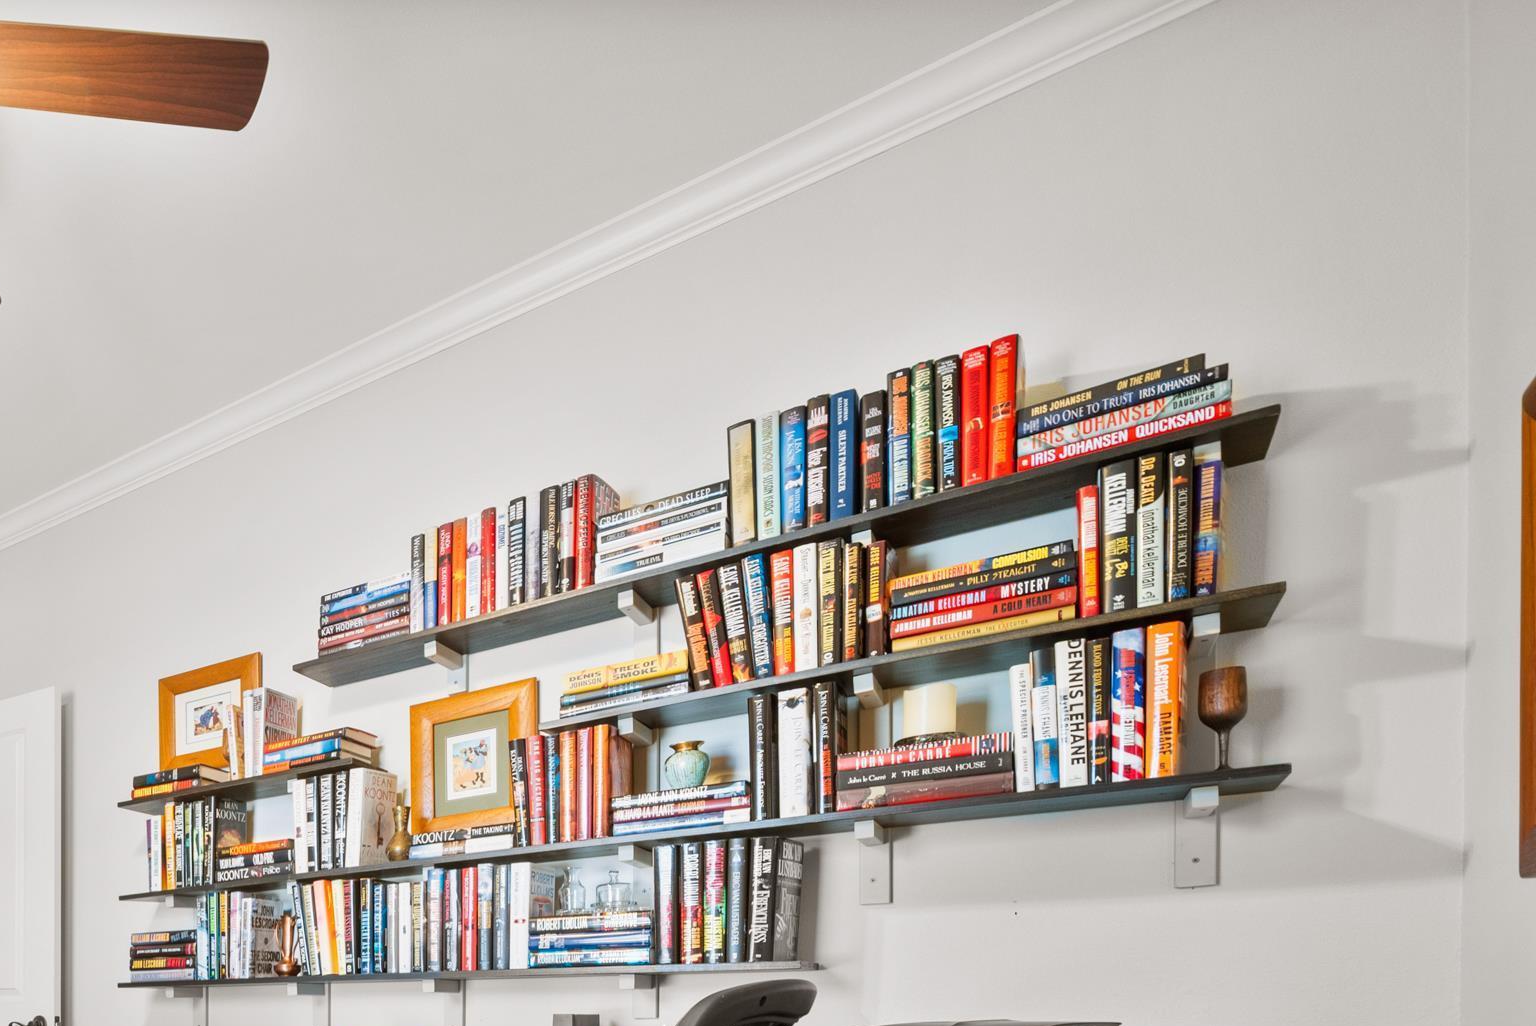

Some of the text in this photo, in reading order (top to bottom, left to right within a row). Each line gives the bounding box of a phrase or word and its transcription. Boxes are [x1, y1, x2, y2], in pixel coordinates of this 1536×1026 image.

[1117, 369, 1162, 391] ON THE RUN
[1139, 373, 1201, 400] IRIS JOHANSEN
[916, 368, 931, 435] IRIS JOHANSEN
[942, 374, 953, 428] IRIS JOHANSEN
[1031, 391, 1092, 417] IRIS JOHANSEN
[1044, 391, 1134, 428] NO ONE TO TRUST
[1030, 406, 1215, 466] IRIS JOHANSEN QUICKSAND
[1031, 396, 1166, 450] IRIS JOHANSEN
[838, 430, 847, 492] SILENT PARTNER
[894, 439, 907, 493] DARK SUMMER
[917, 437, 931, 482] DEADLOCK
[944, 440, 954, 478] FATAL TIDE
[1141, 457, 1156, 504] DR. DEATH
[658, 487, 711, 509] DEAD SLEEP
[1105, 472, 1126, 535] KELLERMAN
[1177, 487, 1188, 568] DOUBLE HOMICIDE
[992, 546, 1049, 569] COMPULSION
[1141, 547, 1158, 588] kellerman
[724, 566, 739, 585] FAYE
[870, 546, 880, 602] JESSE KELLERMAN
[1000, 577, 1050, 598] MYSTERY
[746, 559, 765, 617] FAYE KELLERMAN
[774, 557, 791, 626] FAYE KELLERMAN
[722, 587, 745, 638] KELLERMAN
[893, 591, 986, 619] JONATHAN KELLERMAN
[1001, 599, 1022, 612] COLD
[1026, 593, 1052, 608] HEART
[321, 619, 364, 637] KAY HOOPER
[895, 610, 973, 632] JONATHAN KELLERMAN
[940, 627, 981, 641] KELLERMAN
[752, 623, 769, 665] FORGOTTEN
[1093, 644, 1102, 667] BLOOD
[569, 671, 602, 689] DENIS JOHNSON
[613, 667, 657, 680] SMOKE
[614, 664, 641, 673] TREE
[1093, 668, 1102, 686] FROM
[1154, 633, 1174, 704] John Lescroart
[1068, 639, 1086, 765] DENNIS LEHANE
[1093, 694, 1102, 715] STONE
[510, 750, 519, 783] KOONTZ
[922, 766, 953, 775] RUSSIA
[955, 761, 987, 771] HOUSE
[533, 778, 542, 812] PICTURE
[216, 808, 246, 822] KOONTZ
[415, 830, 454, 845] KOONTZ
[471, 827, 482, 836] THE
[230, 845, 256, 855] KOONTZ
[219, 868, 249, 881] KOONTZ
[537, 918, 561, 931] ROBERT
